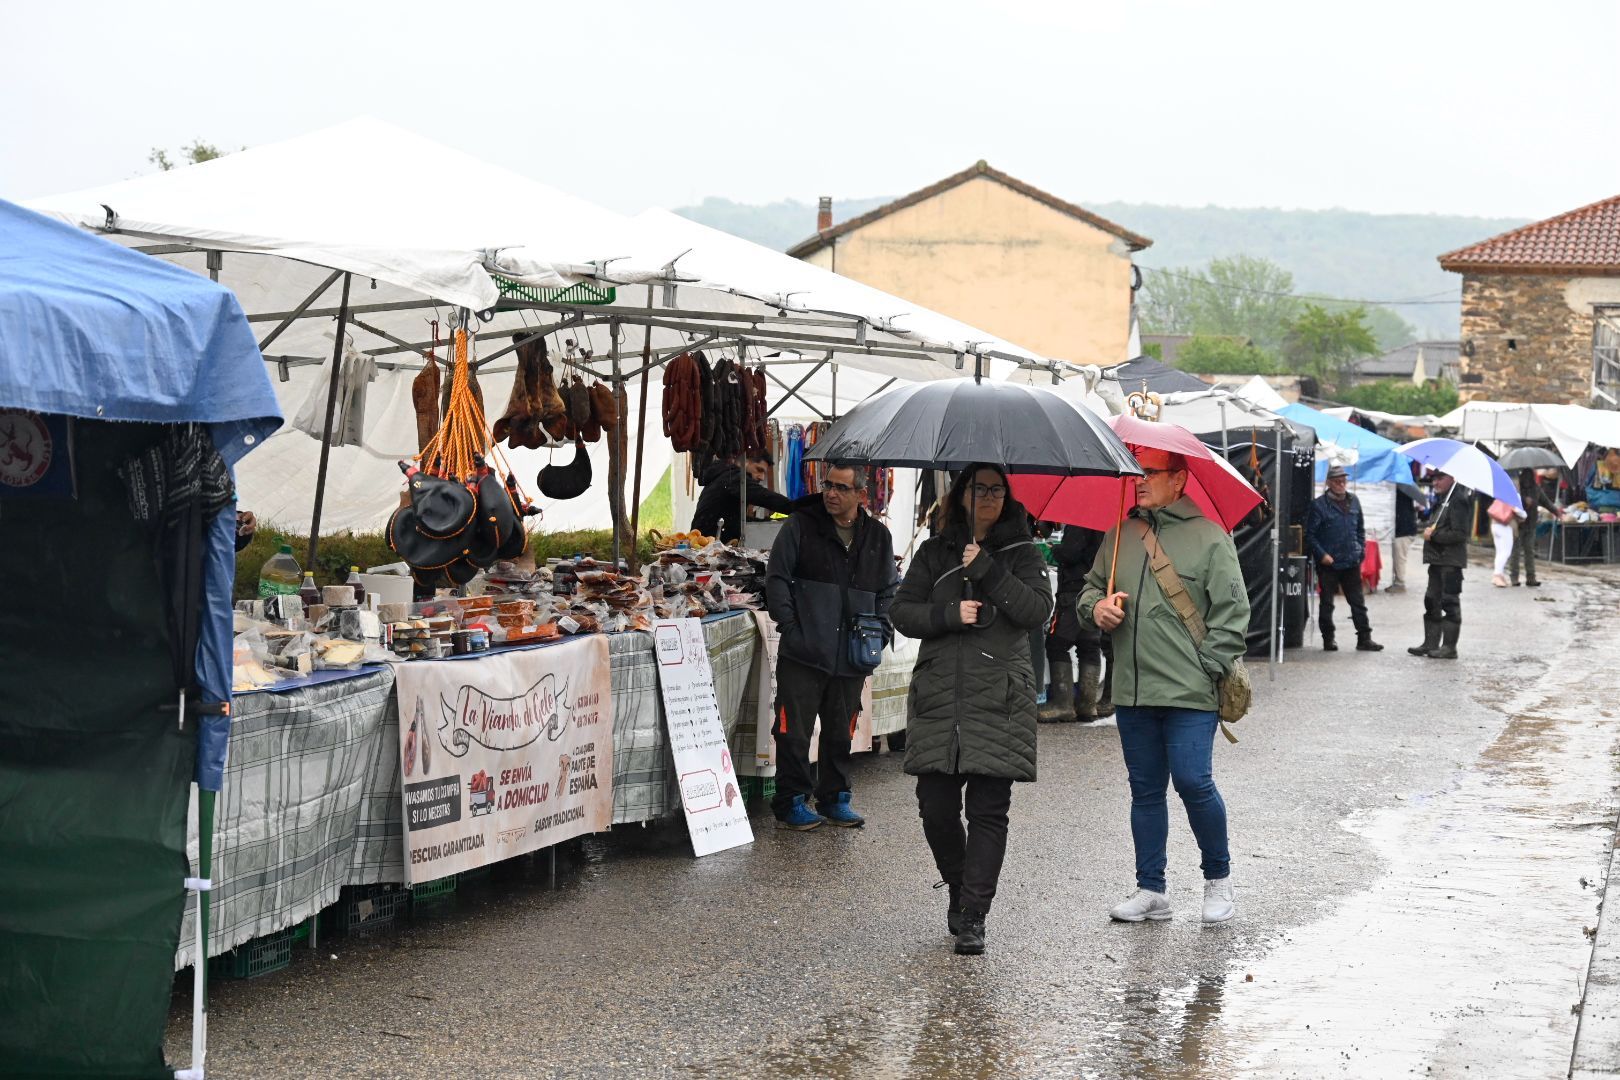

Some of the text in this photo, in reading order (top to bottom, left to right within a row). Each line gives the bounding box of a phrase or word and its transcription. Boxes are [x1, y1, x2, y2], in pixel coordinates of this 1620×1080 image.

[462, 686, 478, 727] La
[500, 760, 532, 786] SE ENVÍA
[586, 755, 596, 769] DE
[569, 770, 598, 795] ESPAÑA
[496, 781, 549, 811] A DOMICILIO
[412, 809, 419, 824] SI
[419, 808, 428, 822] LO
[534, 805, 585, 833] SABOR TRADICIONAL
[442, 833, 485, 858] GARANTIZADA
